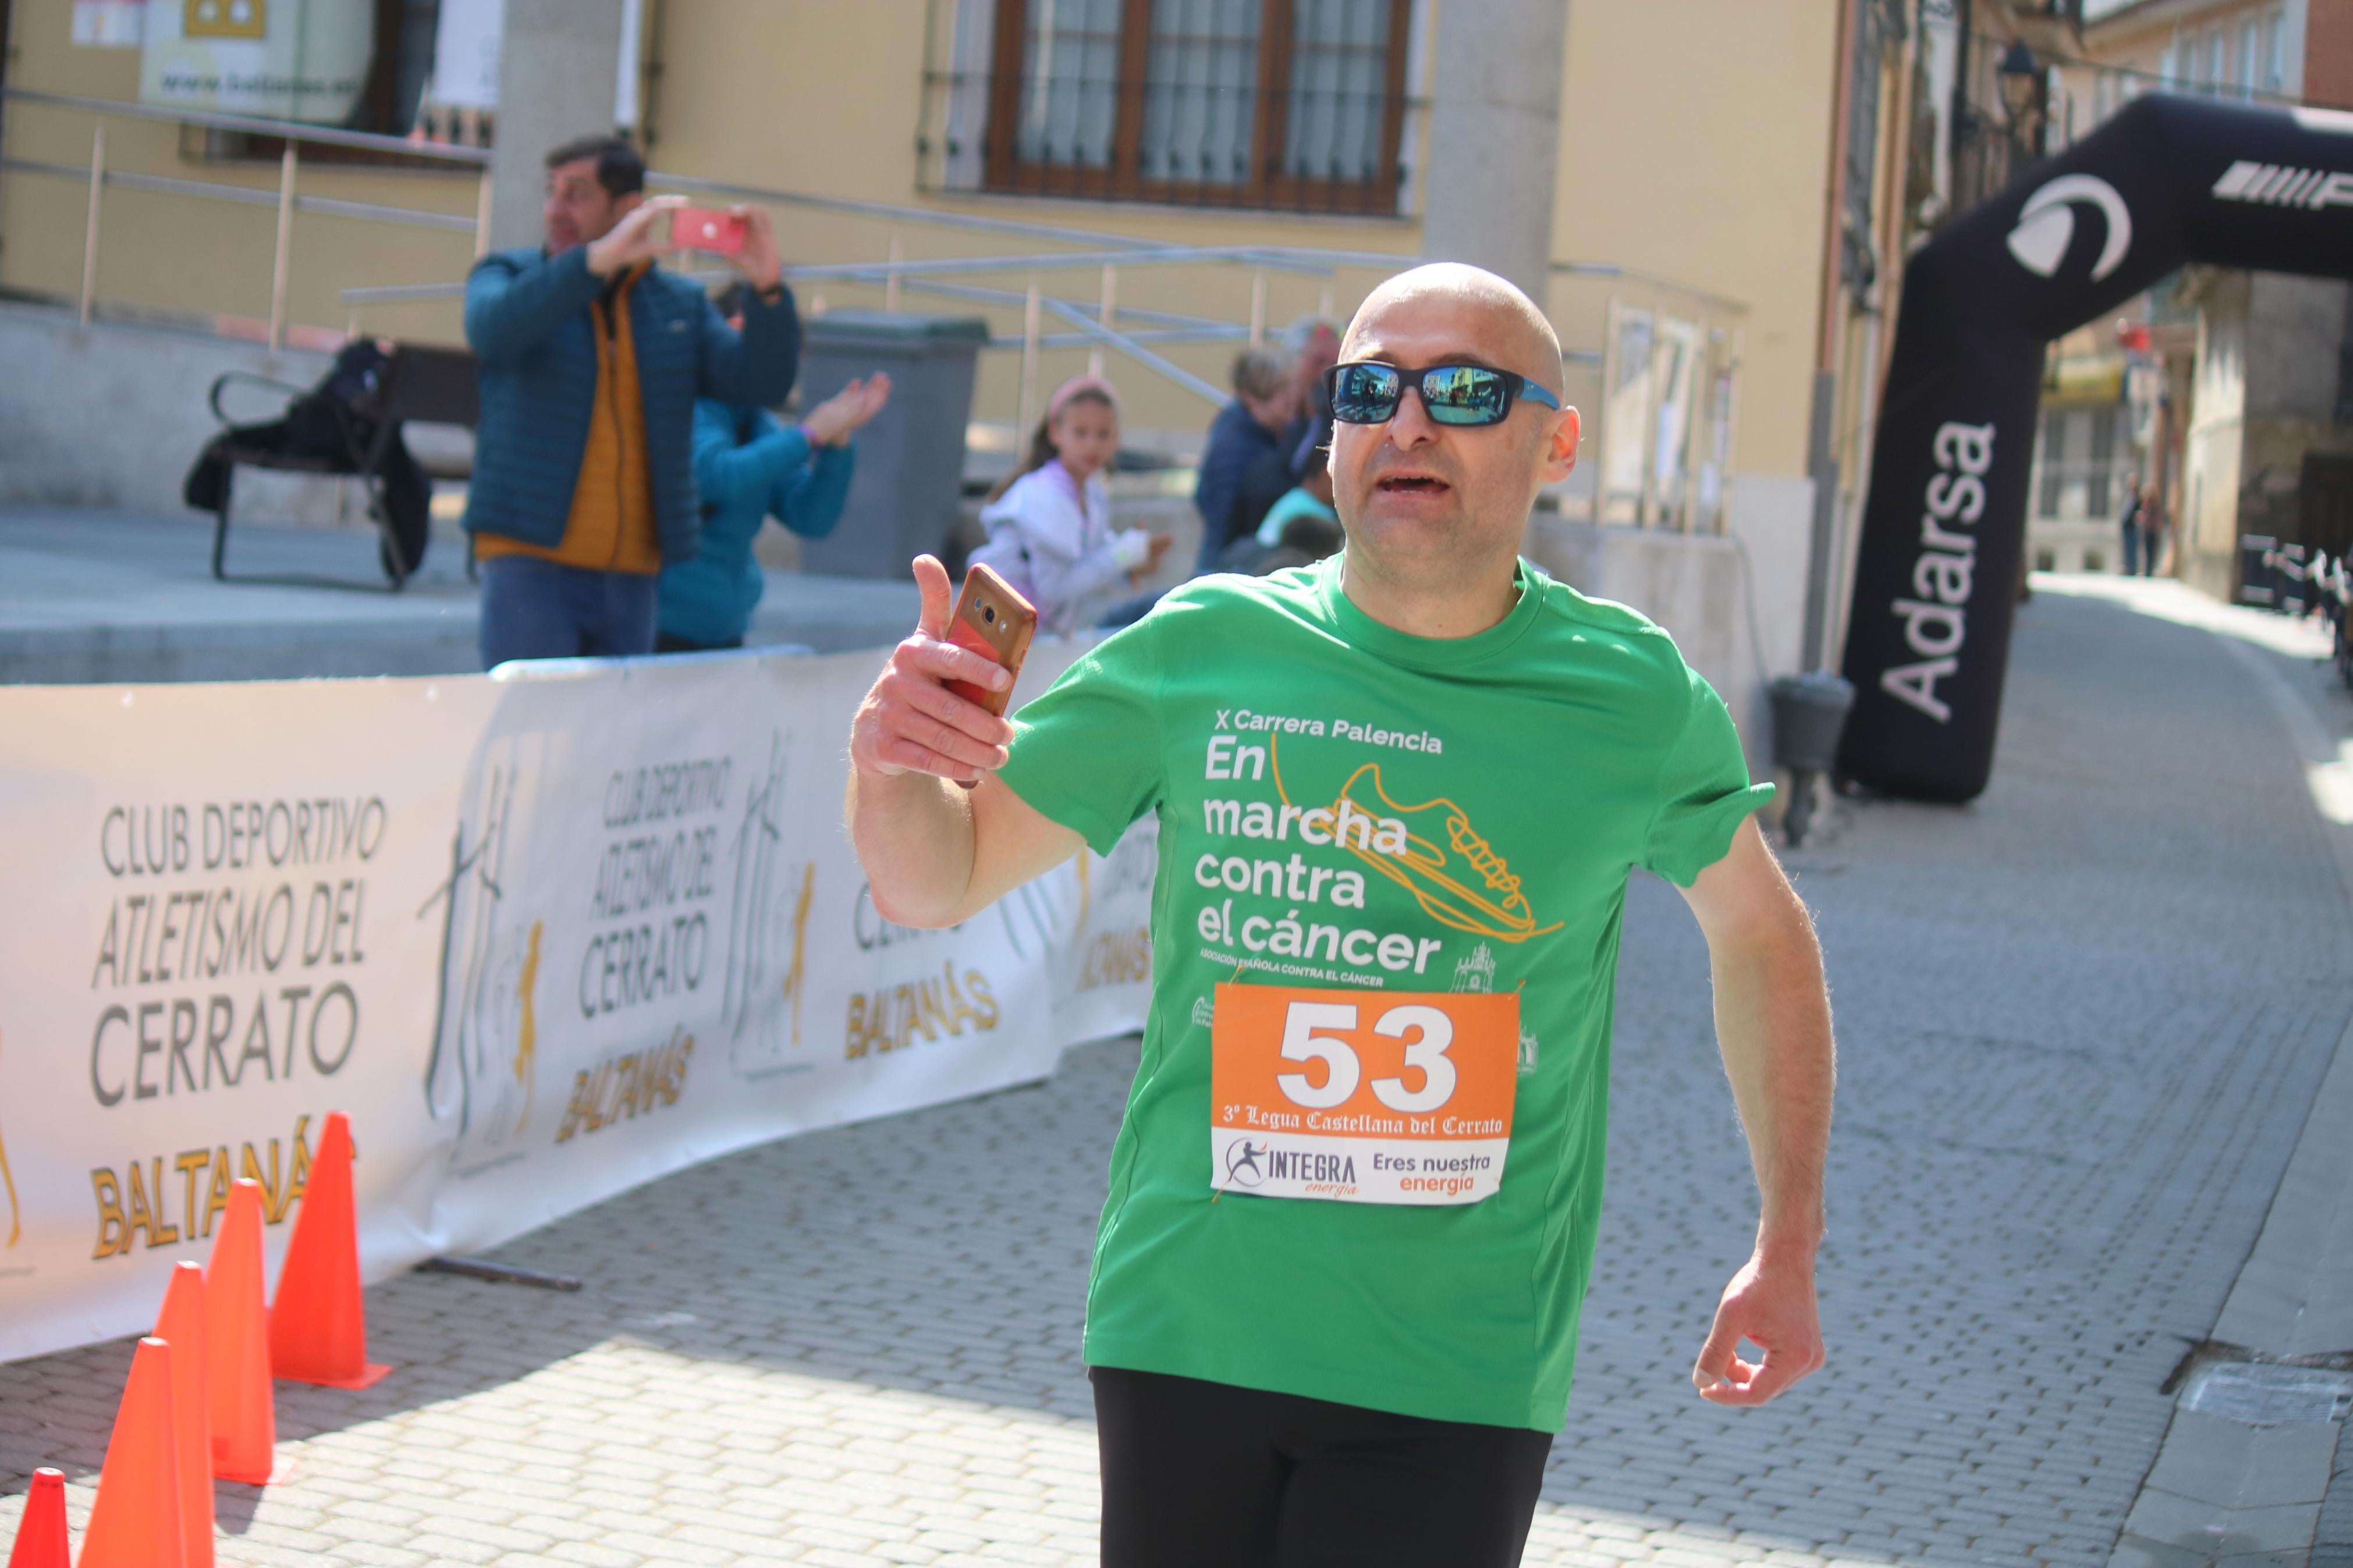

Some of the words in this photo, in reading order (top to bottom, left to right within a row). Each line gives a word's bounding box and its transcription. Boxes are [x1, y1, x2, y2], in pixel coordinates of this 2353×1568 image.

[1879, 421, 1997, 725] Adarsa
[1204, 735, 1266, 780] En
[1215, 709, 1231, 731] X
[1234, 709, 1325, 737] Carrera
[1332, 719, 1443, 755] Palencia
[101, 805, 190, 877] CLUB
[203, 796, 386, 872] DEPORTIVO
[1203, 798, 1407, 856] marcha
[1194, 852, 1366, 909] contra
[91, 882, 294, 990] ATLETISMO
[301, 878, 365, 968] DEL
[579, 911, 709, 1020] CERRATO
[1197, 898, 1234, 947] el
[1241, 909, 1442, 975] cáncer
[1199, 947, 1237, 967] ASOCIACIÓN
[1282, 963, 1324, 980] CONTRA
[1326, 969, 1339, 982] EL
[1340, 972, 1384, 988] CÁNCER
[844, 958, 999, 1061] BALTANÁS
[90, 980, 359, 1108] CERRATO
[1276, 1001, 1456, 1113] 53
[1245, 1105, 1300, 1130] Legua
[1306, 1111, 1403, 1133] Castellana
[1410, 1116, 1436, 1135] del
[1442, 1115, 1503, 1135] Cerrato
[90, 1115, 357, 1260] BALTANÁ
[1269, 1149, 1356, 1183] INTEGRA
[1373, 1153, 1416, 1171] Eres
[1423, 1153, 1490, 1172] nuestra
[1400, 1171, 1474, 1197] energía
